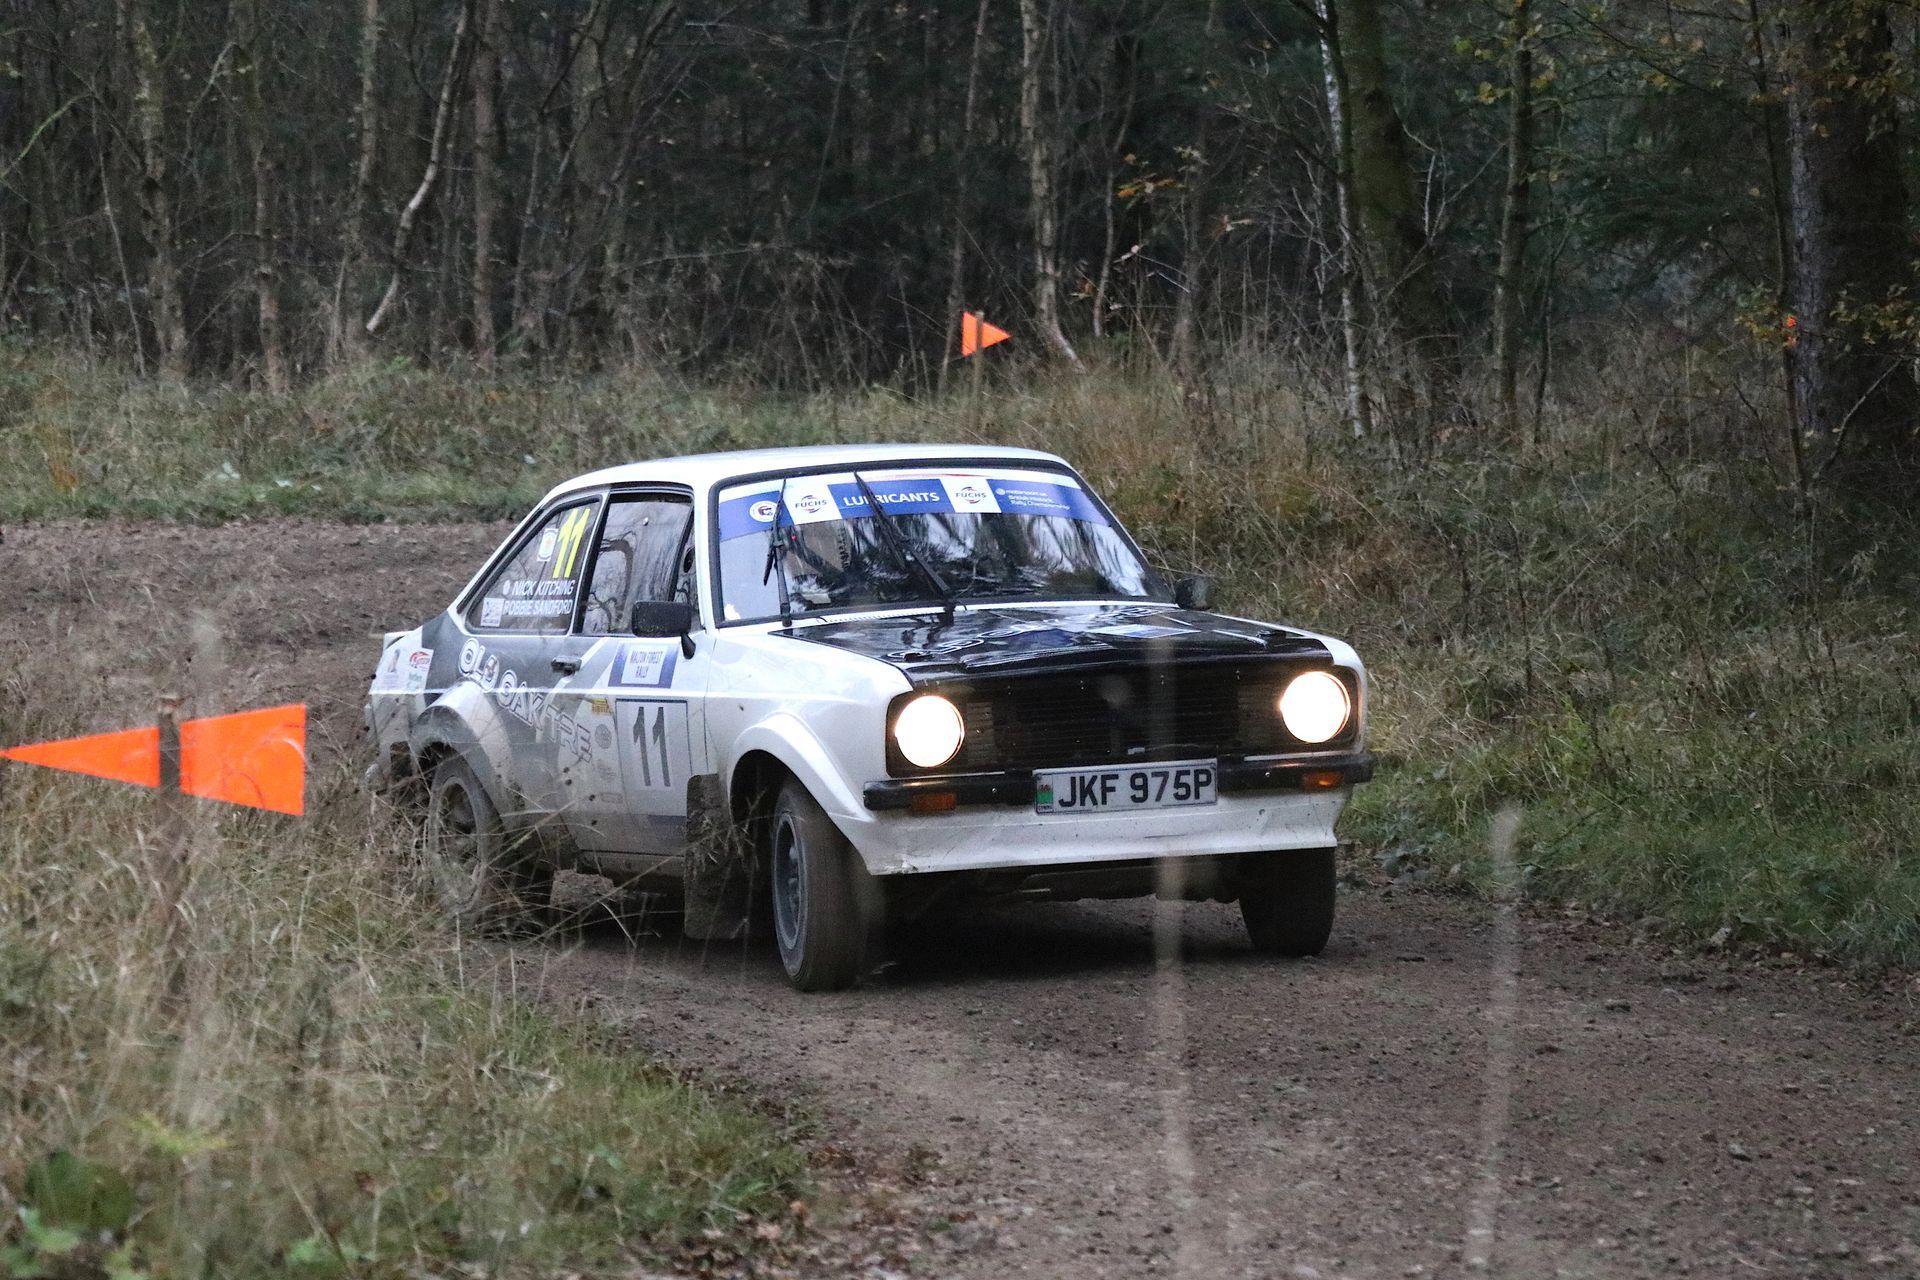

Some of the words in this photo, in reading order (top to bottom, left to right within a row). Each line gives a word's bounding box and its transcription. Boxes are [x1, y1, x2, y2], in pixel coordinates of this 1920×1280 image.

[795, 499, 828, 509] FUCHS
[842, 492, 940, 507] LURICANTS
[552, 508, 591, 579] 11
[511, 580, 537, 596] NICK
[535, 580, 575, 596] KITCHING
[533, 599, 574, 616] SANDFORD
[458, 638, 500, 693] OLD
[496, 669, 546, 732] OAK
[633, 706, 672, 787] 11
[1058, 773, 1120, 808] JKF
[1129, 768, 1212, 804] 975P
